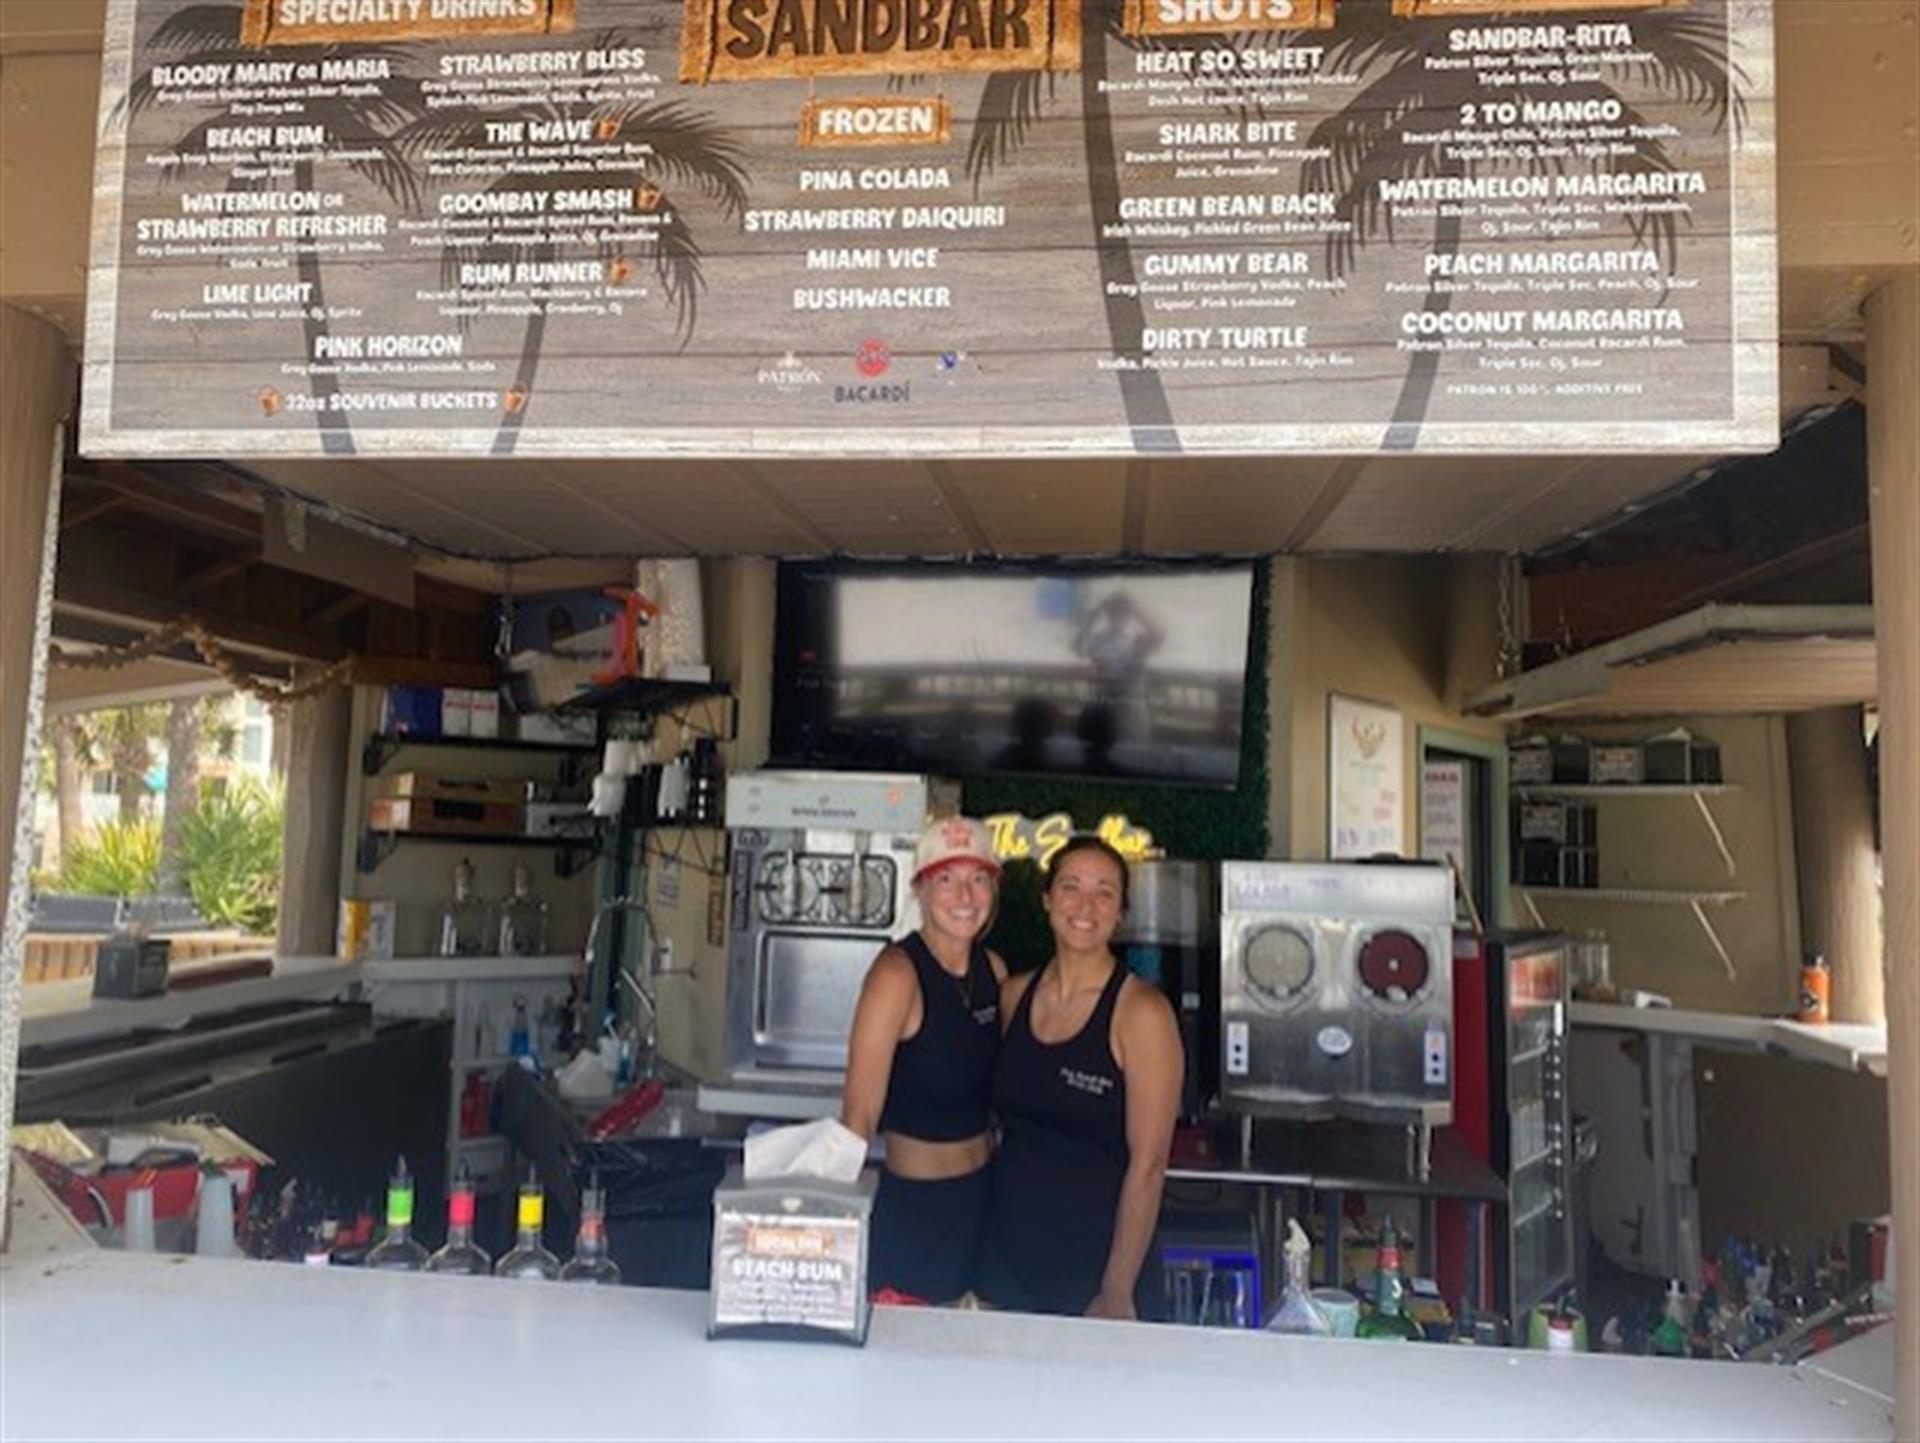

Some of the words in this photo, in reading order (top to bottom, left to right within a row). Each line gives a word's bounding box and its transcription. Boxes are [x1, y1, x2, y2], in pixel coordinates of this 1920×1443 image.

[280, 0, 426, 25] SPECIALTY
[431, 0, 535, 19] DRINKS
[1159, 0, 1294, 22] SHOTS
[725, 0, 1030, 59] SANDBAR
[1449, 24, 1632, 51] SANDBAR-RITA
[440, 52, 581, 75] STRAWBERRY
[586, 49, 645, 70] BLISS
[1136, 52, 1196, 72] HEAT
[1201, 50, 1236, 70] SO
[1242, 48, 1323, 69] SWEET
[152, 64, 231, 86] BLOODY
[236, 62, 294, 82] MARY
[321, 60, 390, 79] MARIA
[819, 107, 932, 134] FROZEN
[1461, 105, 1476, 124] 2
[1481, 103, 1516, 124] TO
[1523, 100, 1621, 122] MANGO
[206, 128, 271, 147] BEACH
[276, 126, 324, 144] BUM
[486, 122, 524, 142] THE
[529, 120, 592, 140] WAVE
[1160, 124, 1240, 144] SHARK
[1247, 122, 1297, 141] BITE
[800, 170, 852, 191] PINA
[860, 168, 949, 189] COLADA
[1379, 176, 1548, 201] WATERMELON
[1555, 172, 1705, 195] MARGARITA
[182, 192, 320, 212] WATERMELON
[440, 192, 549, 213] GOOMBAY
[554, 190, 632, 210] SMASH
[1120, 198, 1196, 218] GREEN
[1202, 196, 1263, 216] BEAN
[1271, 194, 1336, 214] BACK
[137, 218, 272, 240] STRAWBERRY
[276, 216, 387, 235] REFRESHER
[744, 208, 896, 231] STRAWBERRY
[902, 206, 1005, 228] DAIQUIRI
[807, 250, 881, 269] MIAMI
[888, 248, 939, 267] VICE
[1144, 256, 1240, 275] GUMMY
[1248, 253, 1308, 273] BEAR
[1425, 253, 1502, 275] PEACH
[1510, 251, 1659, 273] MARGARITA
[460, 264, 511, 283] RUM
[516, 262, 602, 282] RUNNER
[204, 284, 248, 302] LIME
[254, 283, 312, 302] LIGHT
[794, 287, 951, 309] BUSHWACKER
[1402, 312, 1526, 334] COCONUT
[1533, 309, 1683, 331] MARGARITA
[315, 336, 363, 357] PINK
[367, 335, 463, 356] HORIZON
[1142, 329, 1212, 350] DIRTY
[1219, 326, 1308, 348] TURTLE
[330, 393, 417, 410] SOUVENIR
[421, 392, 498, 409] BUCKETS
[985, 814, 1030, 858] The
